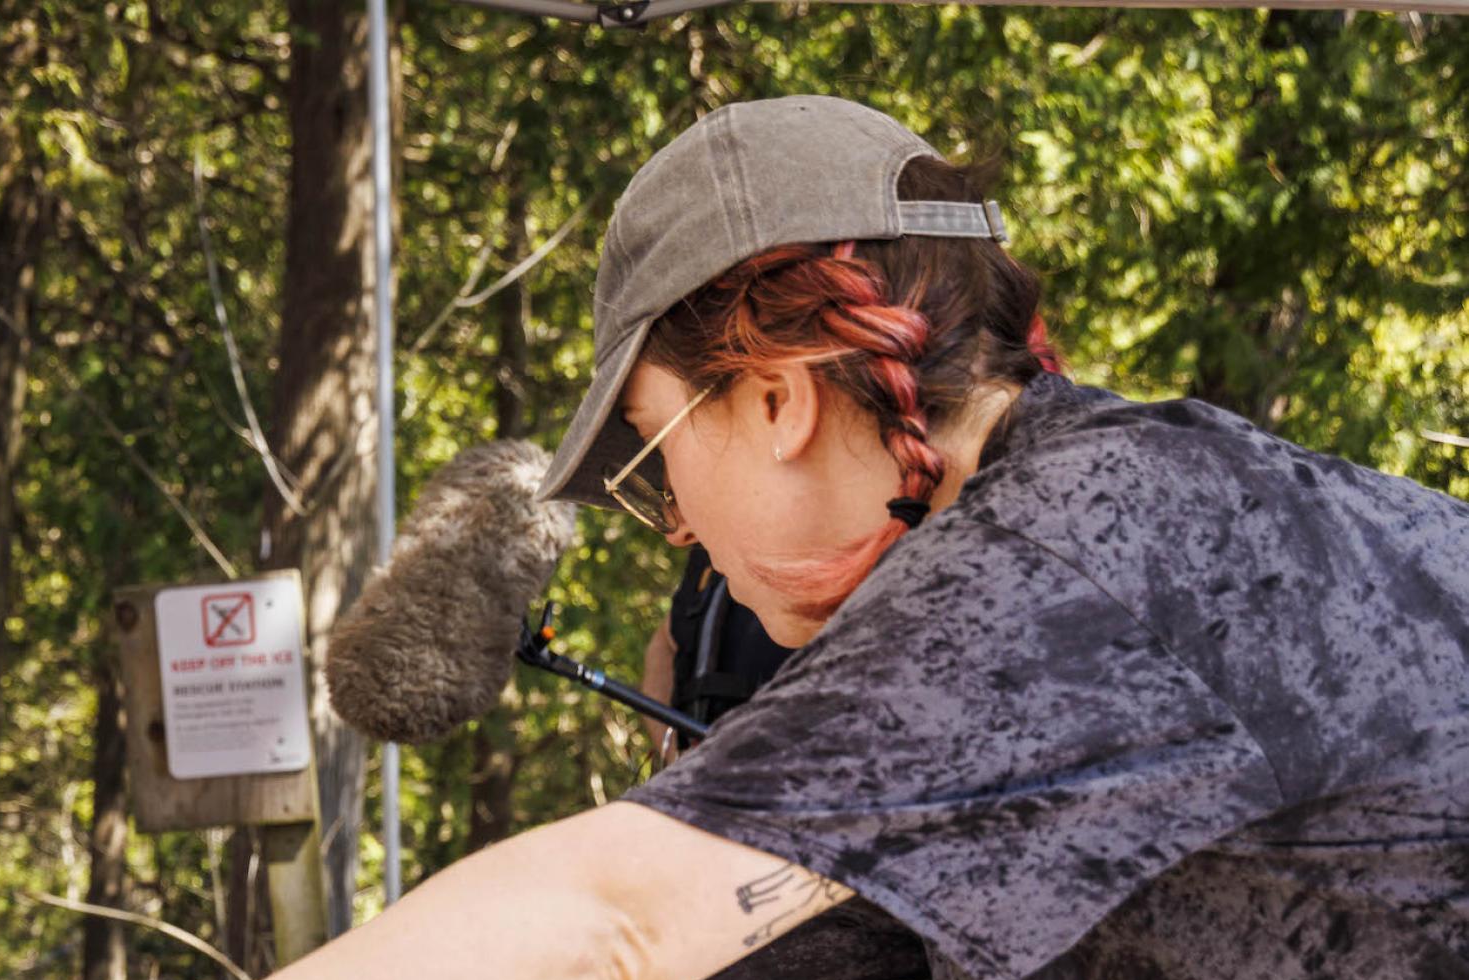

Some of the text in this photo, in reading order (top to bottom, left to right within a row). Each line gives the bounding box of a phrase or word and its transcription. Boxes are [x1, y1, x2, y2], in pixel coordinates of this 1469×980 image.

[171, 649, 294, 672] KEEP OFF THE ICE
[173, 677, 286, 696] RESCUE STATION
